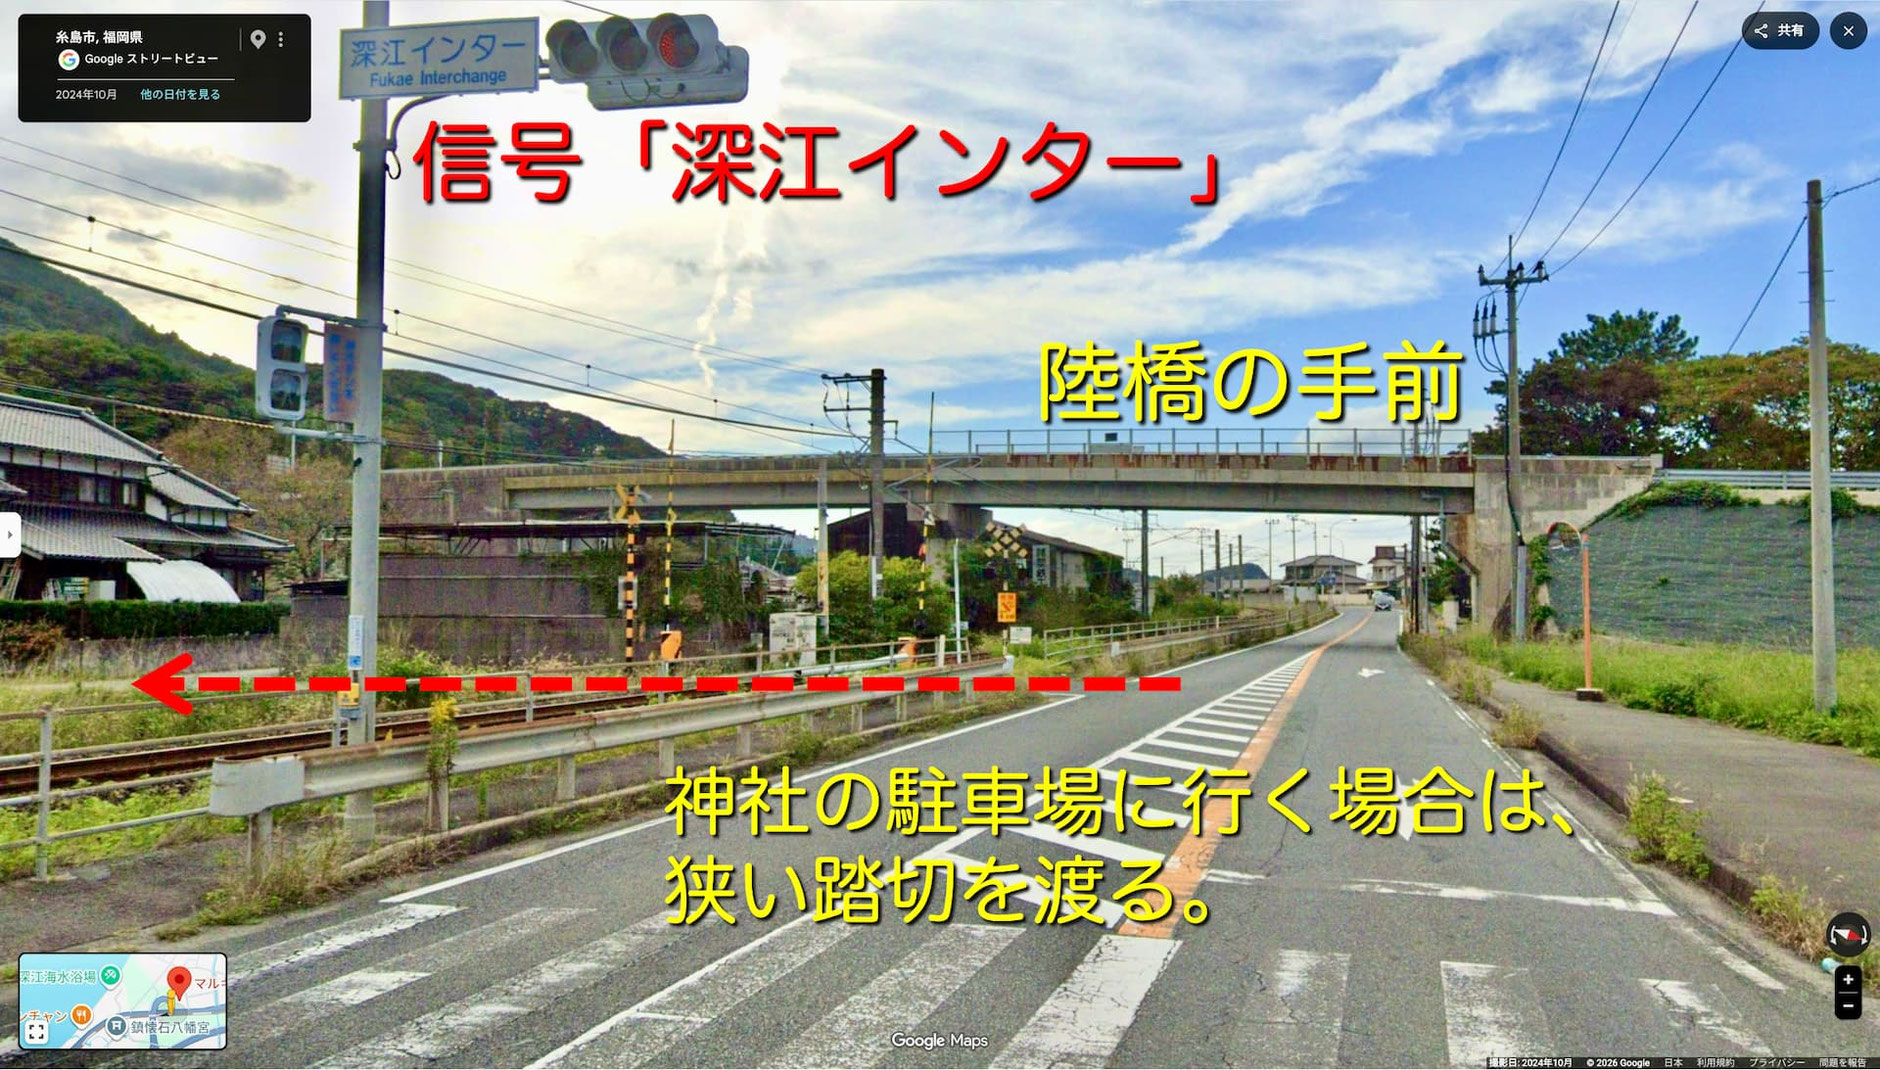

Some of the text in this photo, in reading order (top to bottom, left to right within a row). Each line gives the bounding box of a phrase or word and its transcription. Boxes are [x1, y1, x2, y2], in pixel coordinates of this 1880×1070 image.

[350, 34, 526, 68] 深江インター
[370, 68, 507, 87] Fukae Interchange
